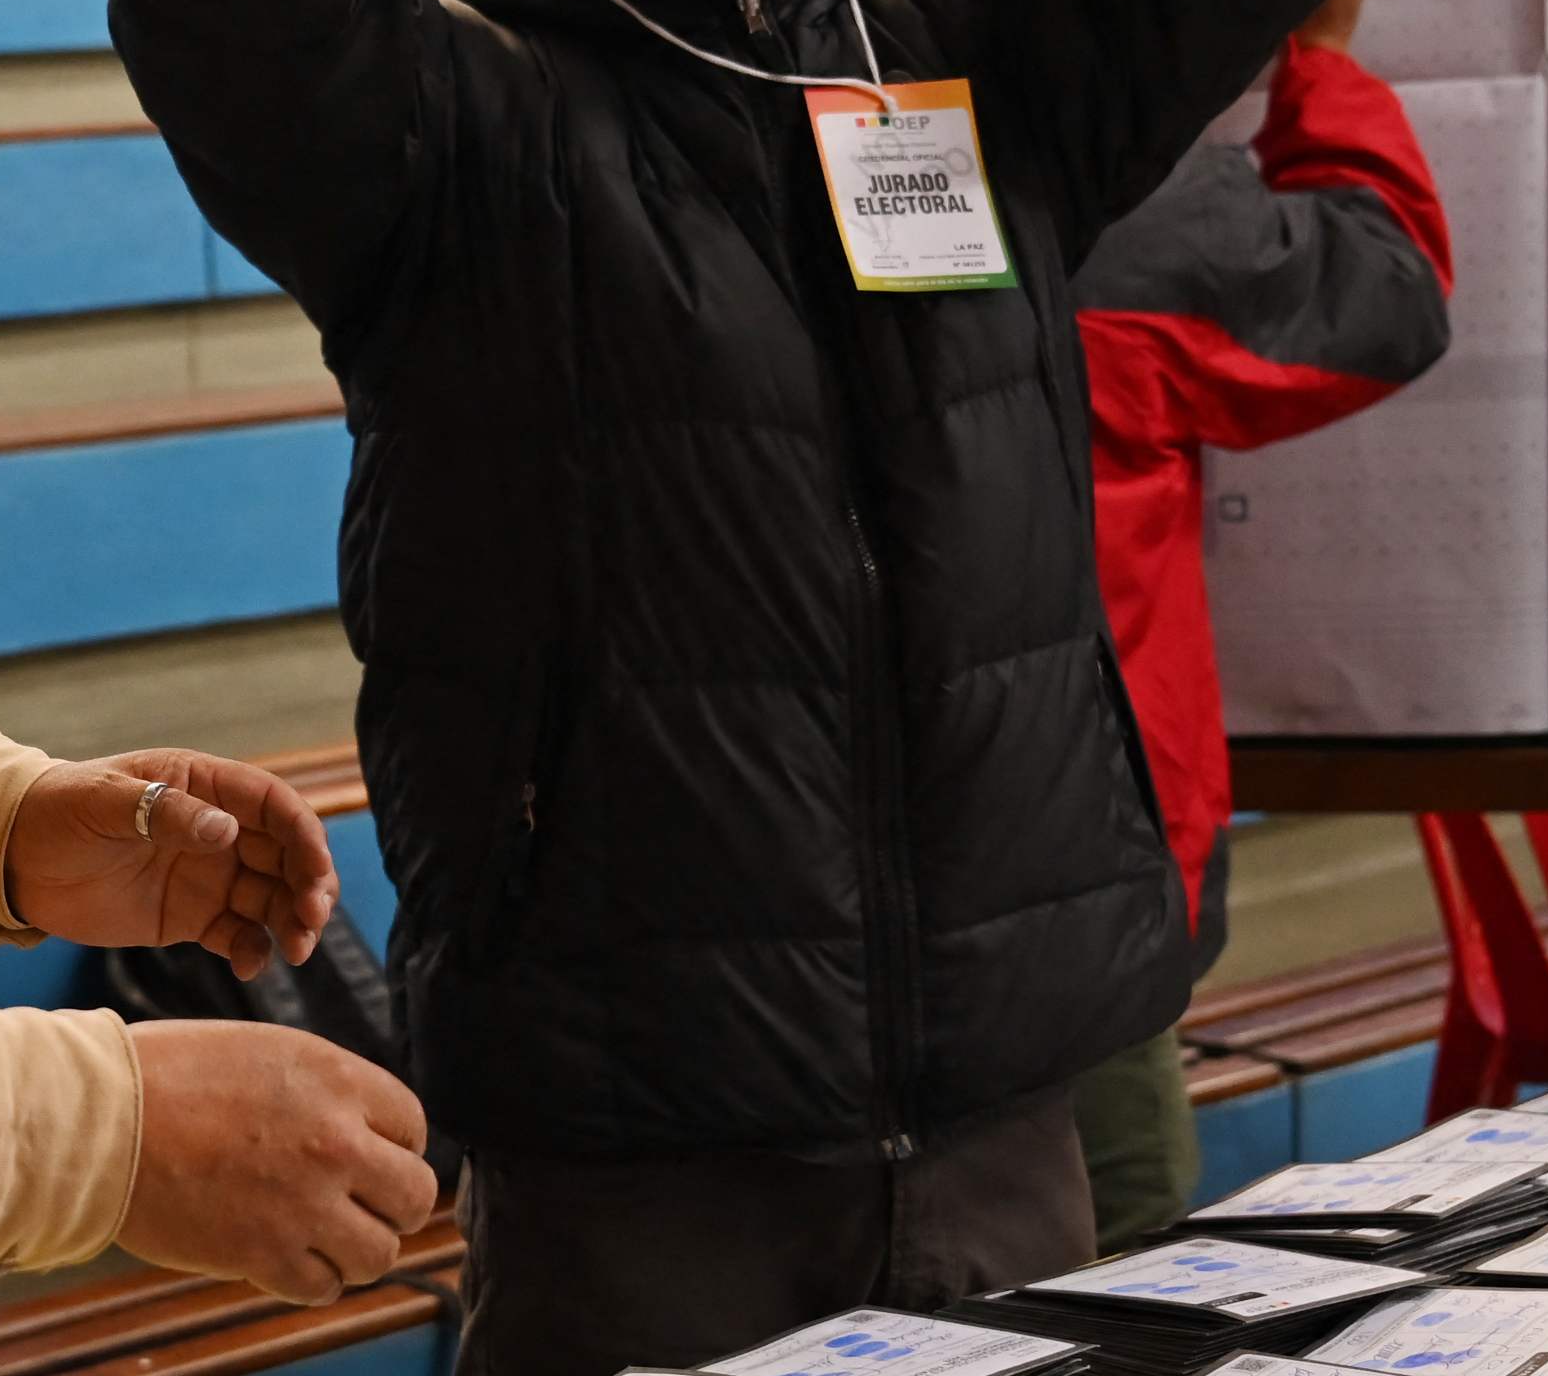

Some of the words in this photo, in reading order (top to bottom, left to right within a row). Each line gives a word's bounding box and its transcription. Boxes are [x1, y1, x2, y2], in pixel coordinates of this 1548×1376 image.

[892, 115, 932, 131] OEP
[866, 172, 950, 196] JURADO
[853, 194, 974, 216] ELECTORAL
